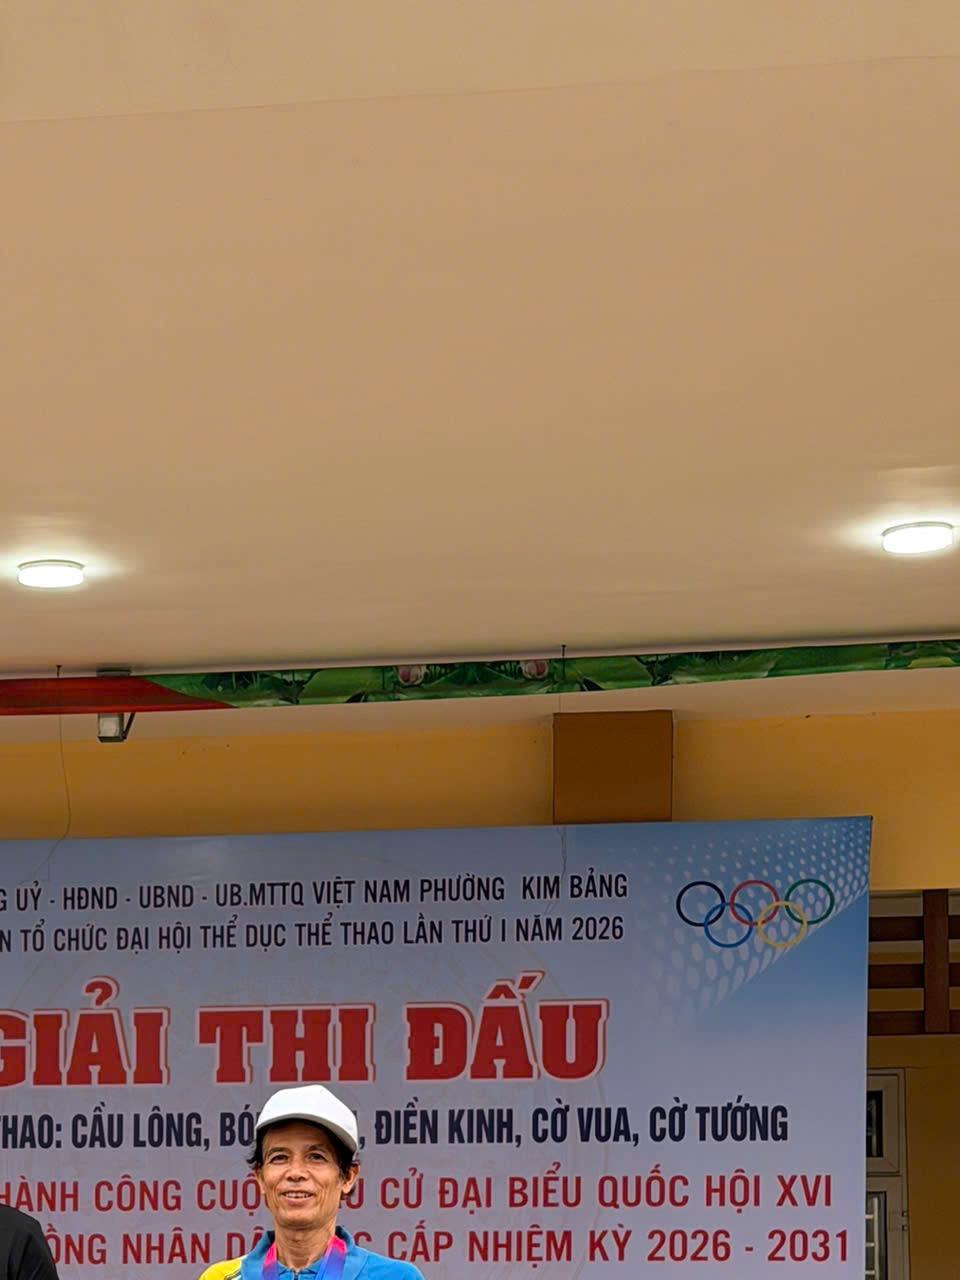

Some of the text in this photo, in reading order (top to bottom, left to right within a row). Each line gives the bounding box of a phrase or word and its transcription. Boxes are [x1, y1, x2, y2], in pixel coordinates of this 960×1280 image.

[16, 880, 41, 911] UỶ
[63, 886, 117, 910] HĐND
[139, 884, 194, 909] UBND
[216, 881, 304, 907] UB.MTTQ
[312, 876, 355, 908] VIỆT
[364, 879, 410, 903] NAM
[420, 873, 505, 902] PHƯỜNG
[522, 876, 560, 899] KIM
[570, 868, 628, 898] BẢNG
[20, 918, 45, 952] TỔ
[54, 923, 108, 951] CHỨC
[116, 926, 148, 955] ĐẠI
[158, 921, 191, 953] HỘI
[200, 914, 238, 948] THỂ
[245, 923, 286, 952] DỤC
[294, 912, 333, 946] THỂ
[340, 921, 394, 946] THAO
[403, 912, 442, 944] LẦN
[451, 914, 492, 943] THỨ
[501, 918, 506, 942] I
[516, 914, 562, 942] NĂM
[572, 916, 623, 940] 2026
[198, 1003, 375, 1084] THI
[405, 970, 609, 1082] ĐẤU
[72, 1102, 123, 1148] CẦU
[134, 1105, 210, 1151] LÔNG,
[374, 1097, 438, 1144] ĐIỀN
[448, 1107, 522, 1147] KINH,
[532, 1098, 569, 1144] CỜ
[577, 1106, 639, 1147] VUA,
[649, 1097, 688, 1143] CỜ
[696, 1094, 788, 1142] TƯỚNG
[94, 1174, 181, 1212] CÔNG
[196, 1172, 269, 1216] CUỘ
[380, 1167, 424, 1209] CỬ
[438, 1176, 492, 1214] ĐẠI
[508, 1162, 582, 1209] BIỂU
[597, 1163, 689, 1209] QUỐC
[705, 1168, 761, 1213] HỘI
[776, 1175, 832, 1207] XVI
[44, 1223, 106, 1264] ỒNG
[122, 1226, 210, 1264] NHÂN
[387, 1220, 454, 1263] CẤP
[468, 1225, 572, 1268] NHIỆM
[589, 1223, 632, 1262] KỲ
[647, 1229, 732, 1262] 2026
[767, 1228, 848, 1262] 2031
